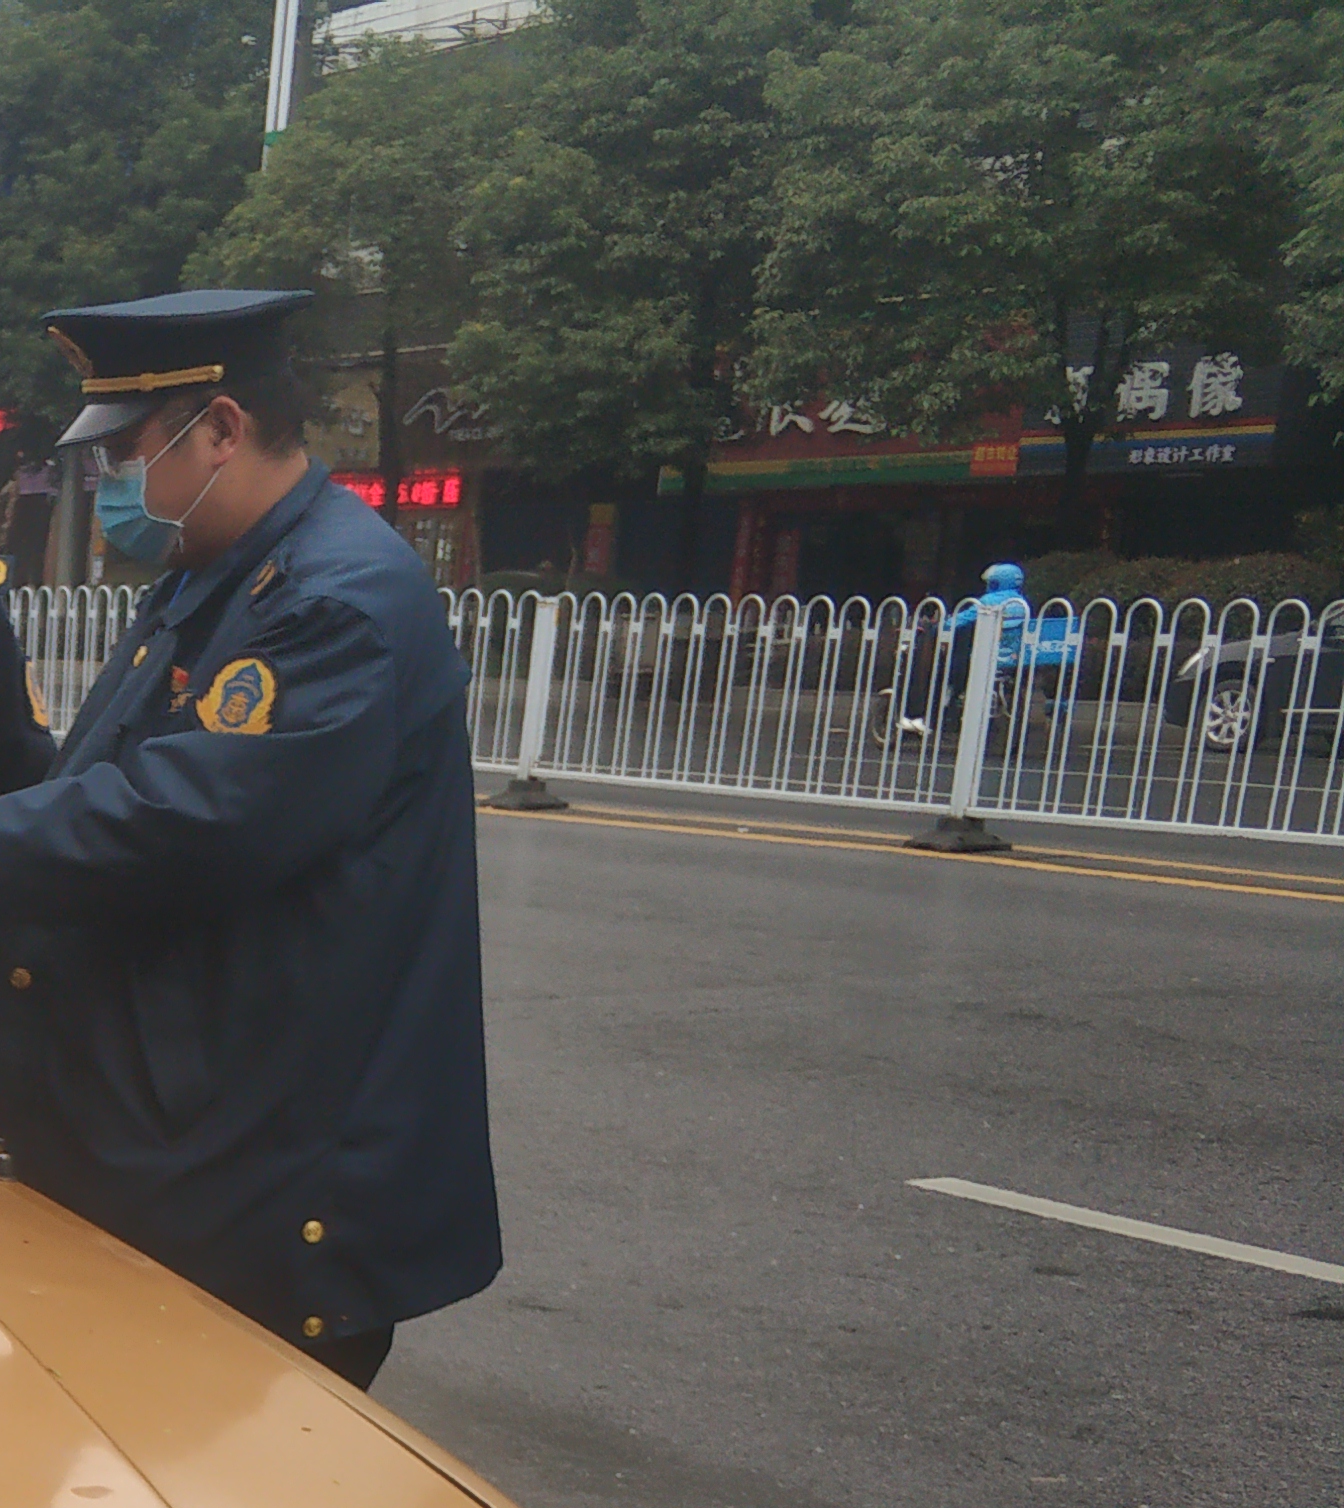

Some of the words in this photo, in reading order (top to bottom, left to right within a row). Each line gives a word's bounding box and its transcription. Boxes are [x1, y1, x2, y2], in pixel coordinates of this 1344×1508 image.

[1128, 443, 1237, 466] 形象设计工作室
